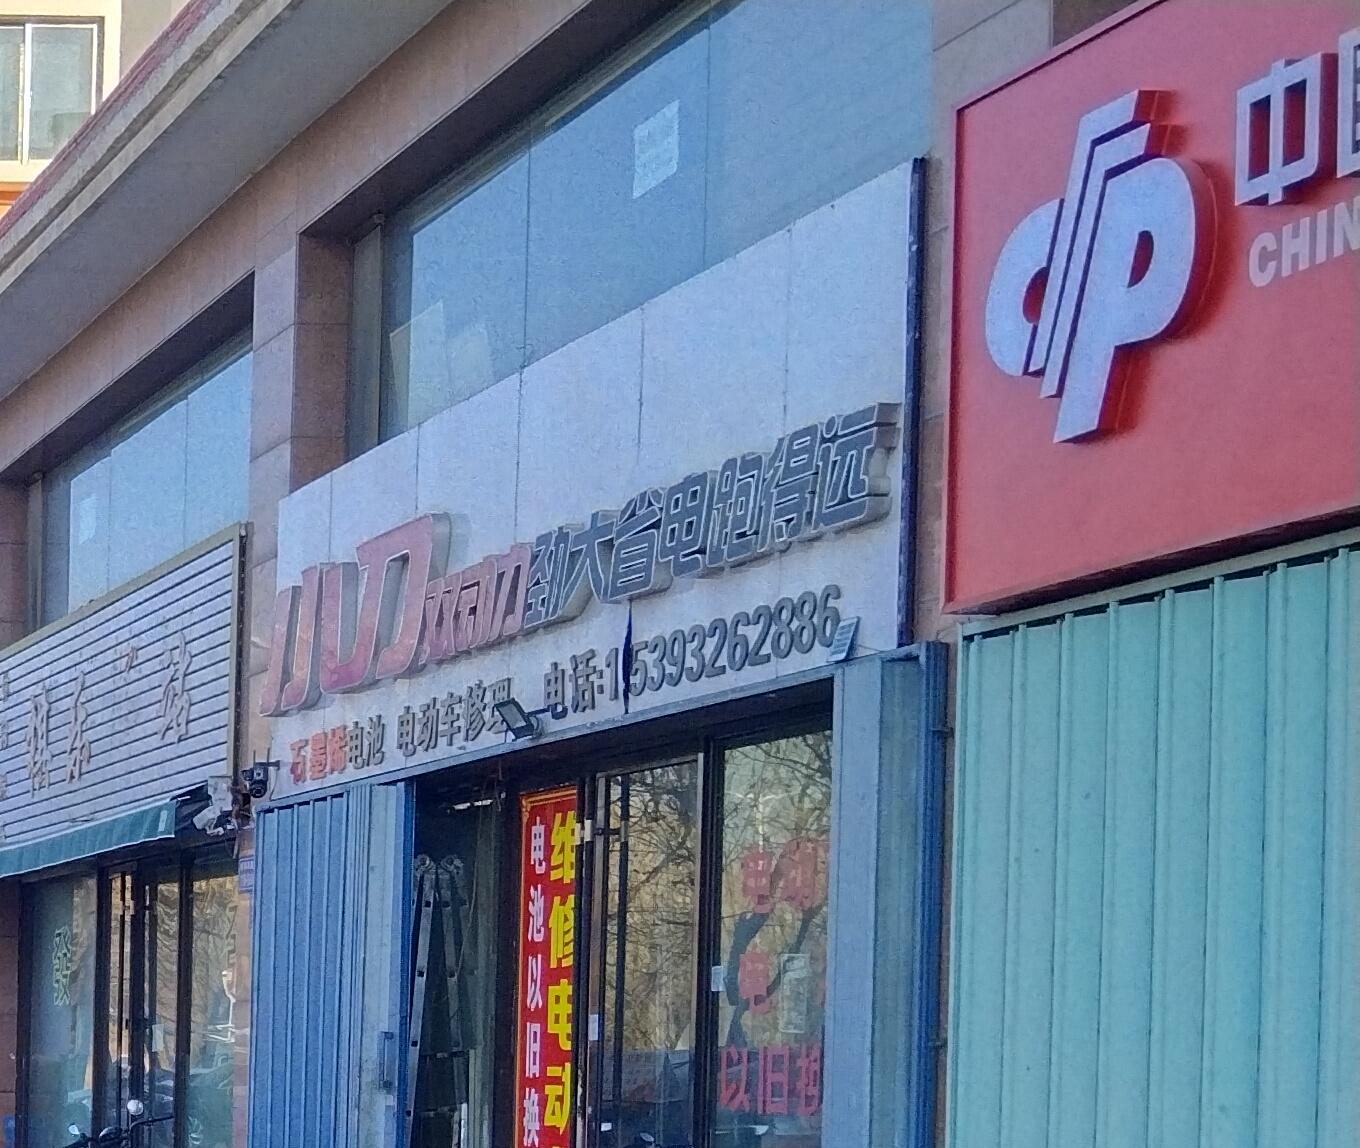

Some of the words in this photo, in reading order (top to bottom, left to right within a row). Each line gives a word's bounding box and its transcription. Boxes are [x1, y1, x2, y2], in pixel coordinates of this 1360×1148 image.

[1235, 28, 1360, 206] 中
[289, 713, 386, 785] 石墨烯电池
